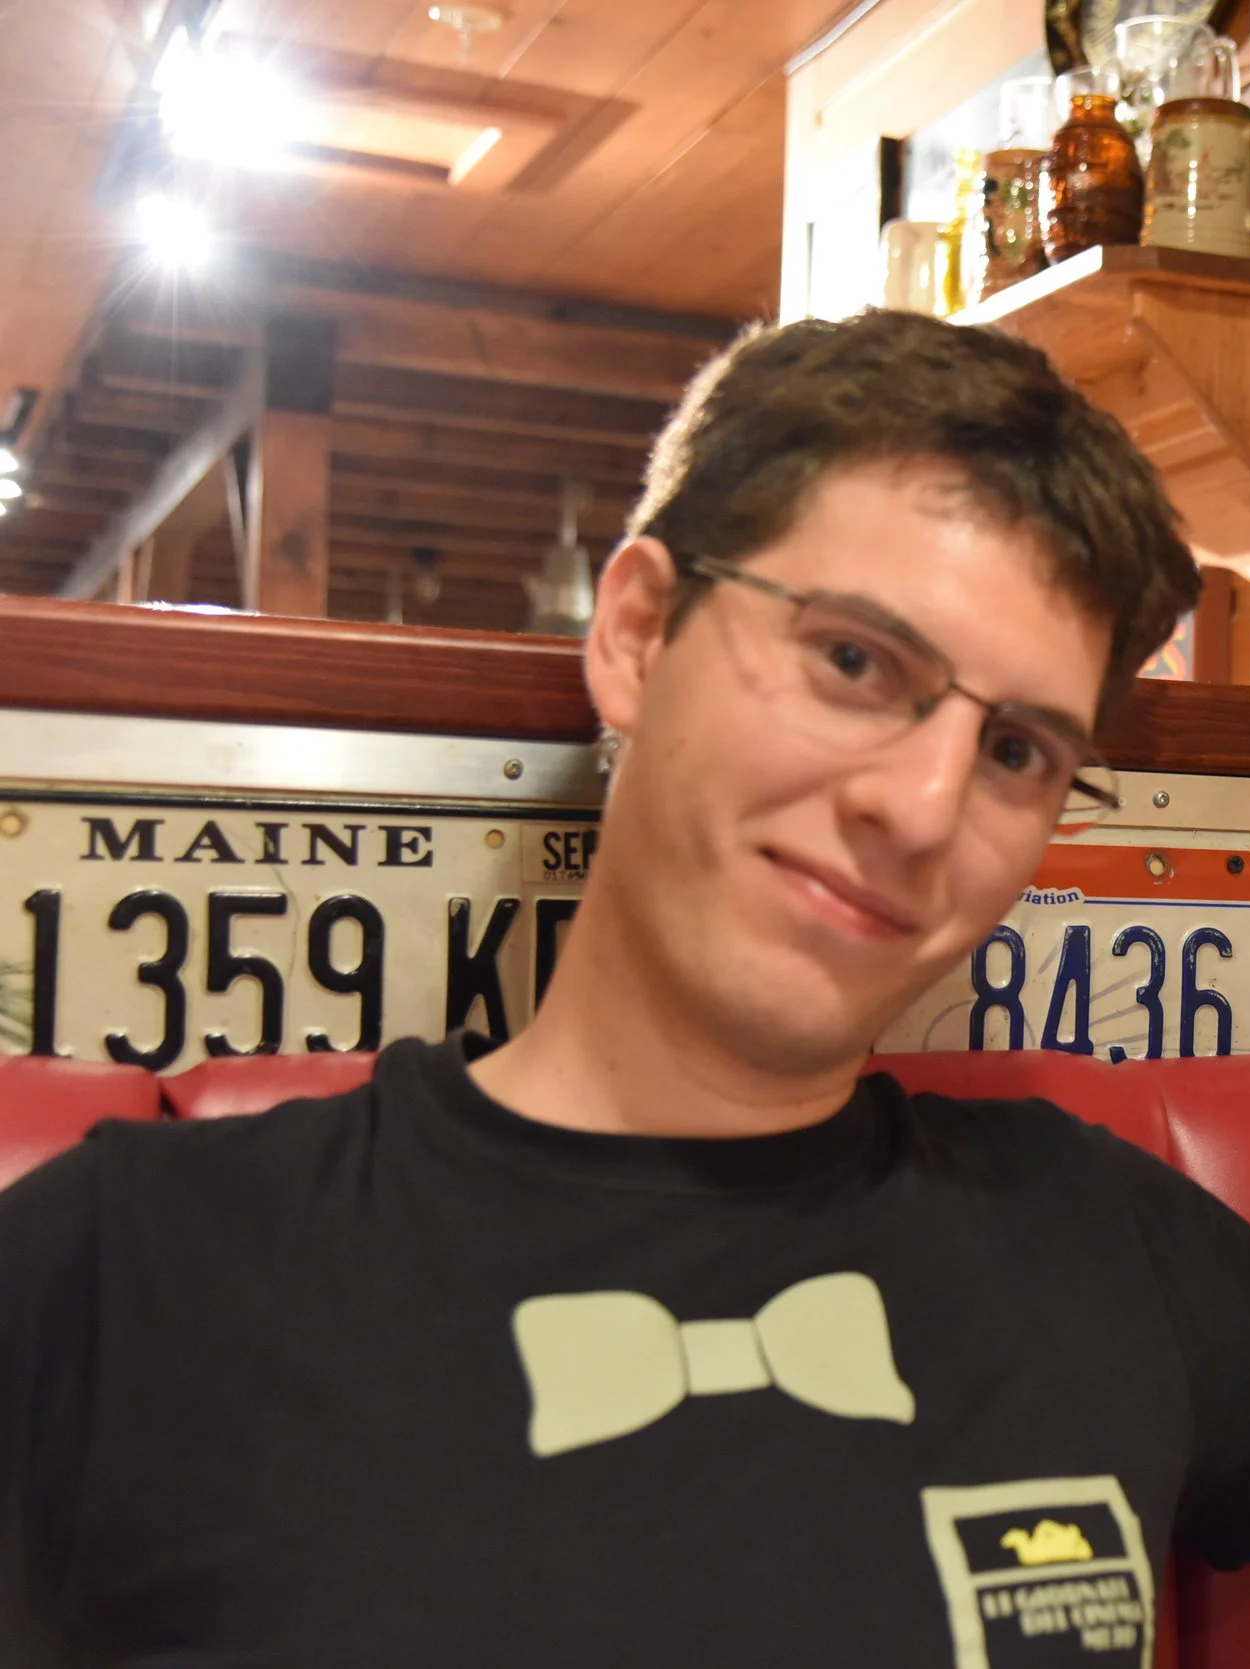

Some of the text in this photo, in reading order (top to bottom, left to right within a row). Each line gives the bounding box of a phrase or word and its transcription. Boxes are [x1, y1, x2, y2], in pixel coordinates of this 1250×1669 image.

[80, 816, 435, 868] MAINE
[23, 887, 386, 1072] 1359
[969, 924, 1234, 1065] 8436
